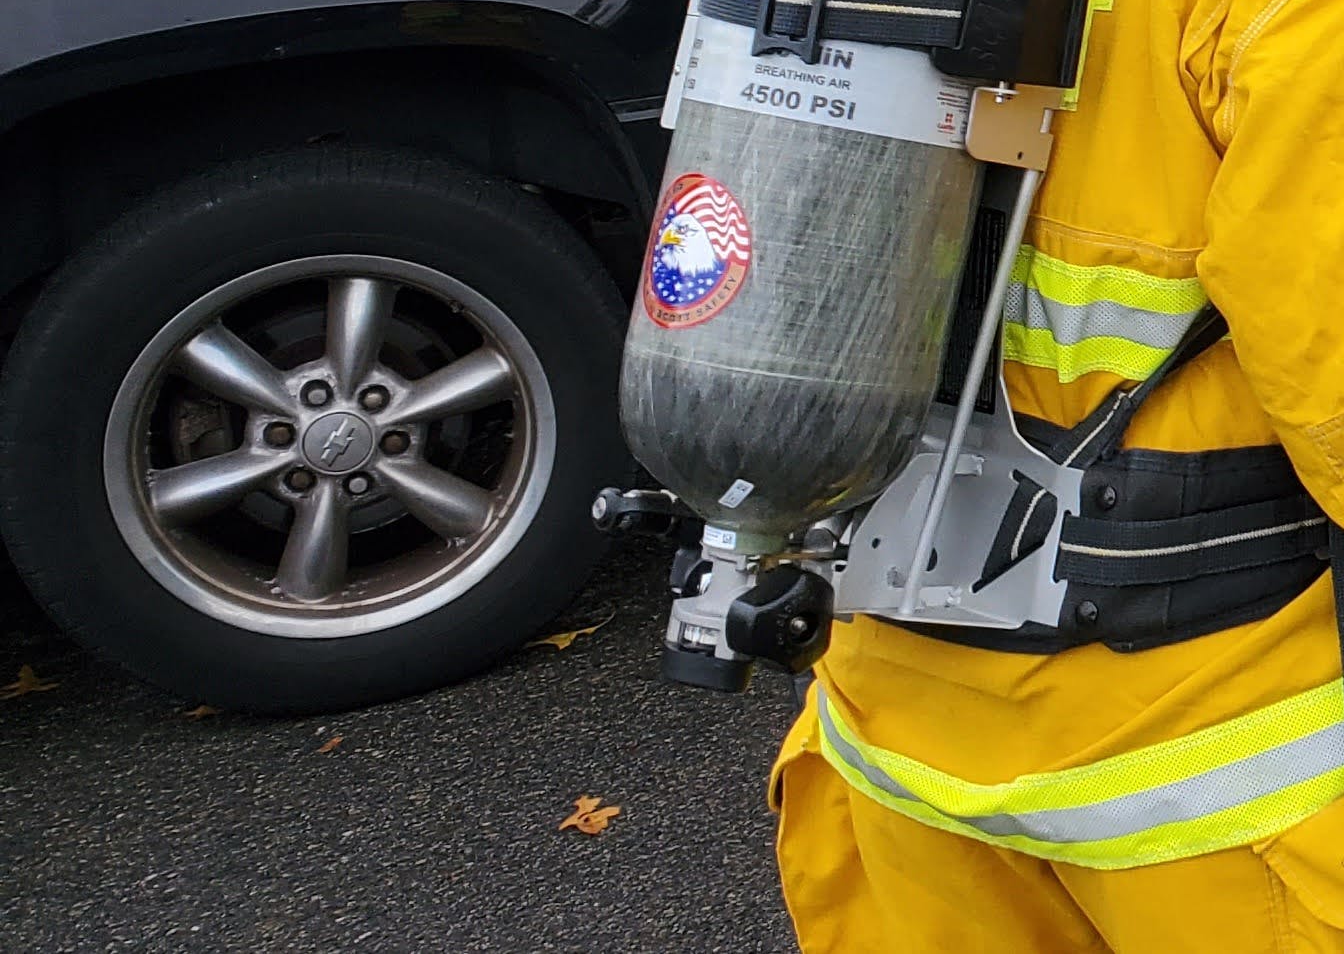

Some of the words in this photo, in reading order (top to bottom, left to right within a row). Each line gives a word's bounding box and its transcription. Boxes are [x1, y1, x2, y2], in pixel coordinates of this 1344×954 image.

[822, 47, 855, 70] IN
[754, 63, 826, 86] BREATHING
[828, 77, 853, 91] AIR
[741, 82, 802, 110] 4500
[809, 94, 857, 121] PSI
[696, 276, 738, 317] SAFETY
